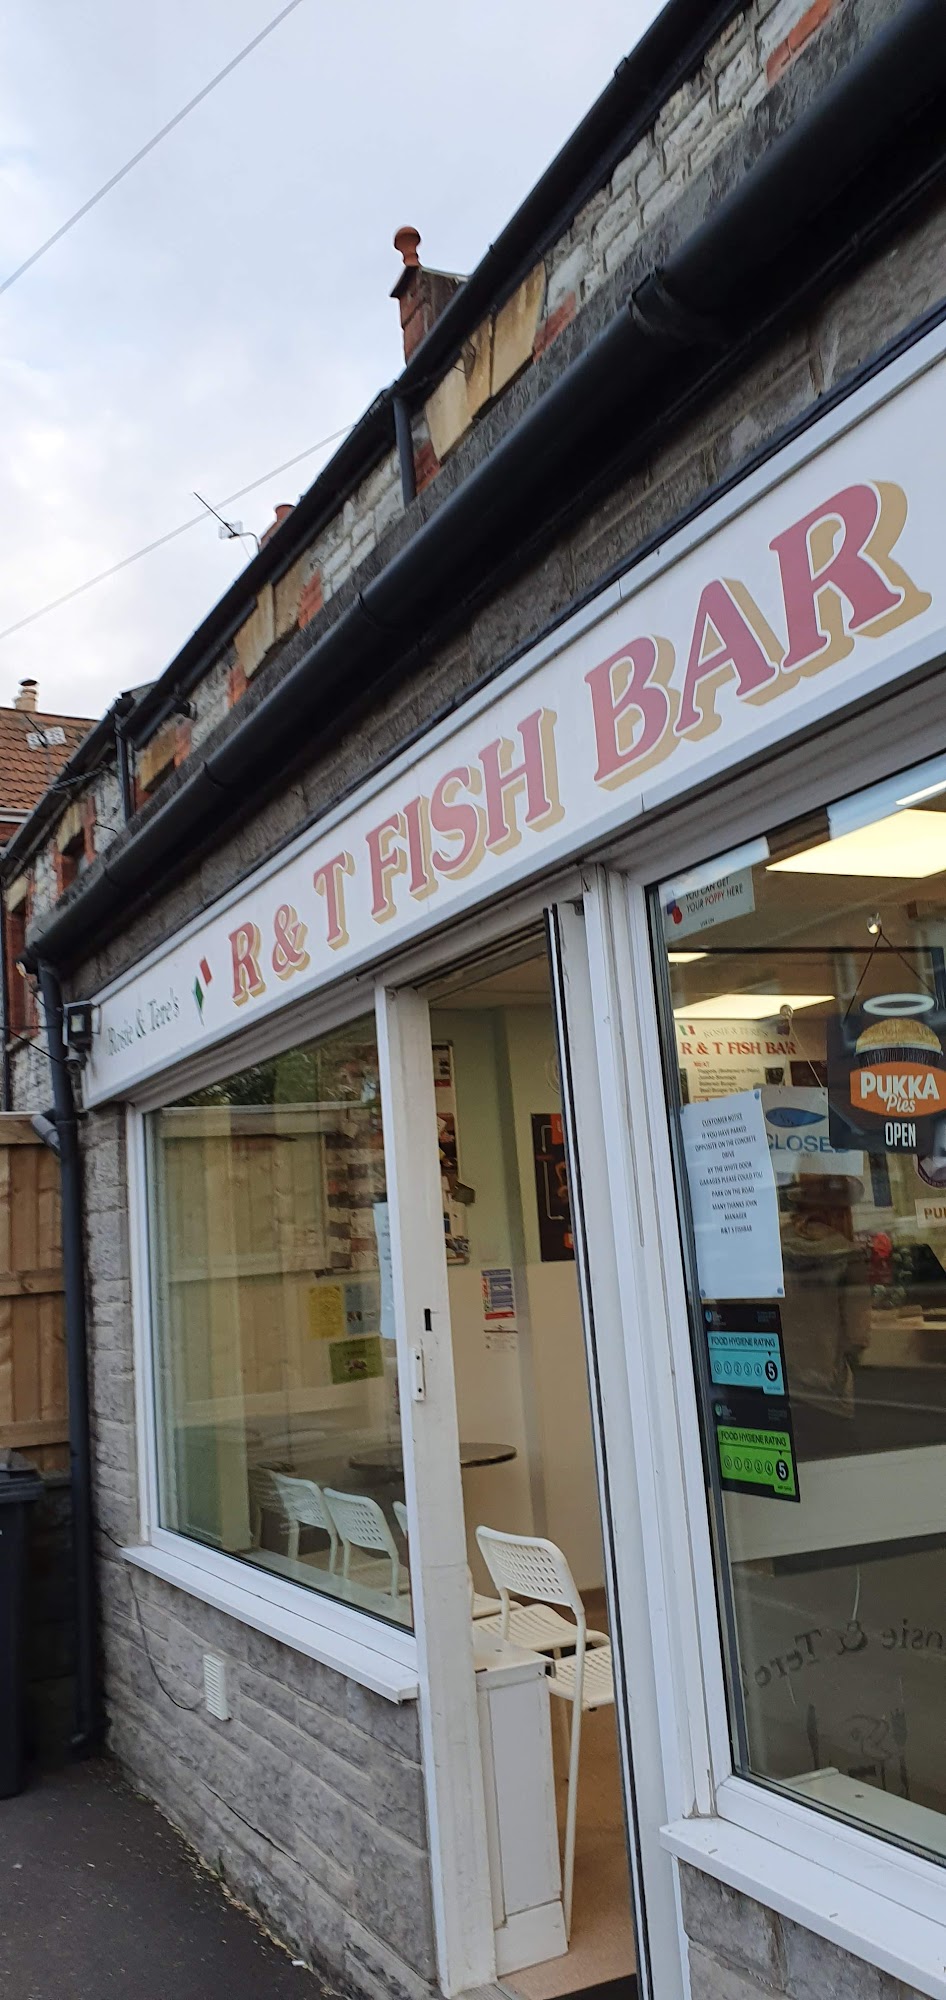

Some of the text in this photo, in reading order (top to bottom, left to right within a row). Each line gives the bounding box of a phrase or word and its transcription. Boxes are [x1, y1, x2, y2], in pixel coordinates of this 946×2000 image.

[229, 480, 933, 1007] R & T FISH BAR
[686, 882, 744, 913] YOUR POPPY HERE
[680, 1041, 797, 1055] R & T FISH BAR
[860, 1071, 940, 1101] PUKKA
[884, 1092, 916, 1114] Pies
[702, 1112, 743, 1127] CUSTOMER NOTICE
[707, 1131, 718, 1139] YOU
[718, 1128, 730, 1137] HAVE
[730, 1126, 747, 1135] PARKED
[885, 1122, 916, 1148] OPEN
[695, 1142, 717, 1152] OPPOSITE
[734, 1135, 756, 1146] CONCRETE
[767, 1134, 848, 1153] LOSE
[722, 1151, 735, 1159] DRIVE
[714, 1165, 723, 1173] THE
[723, 1163, 738, 1172] WHITE
[738, 1161, 752, 1169] DOOR
[699, 1177, 721, 1186] GARAGES
[721, 1174, 737, 1184] PLEASE
[737, 1173, 752, 1182] COULD
[741, 1186, 755, 1194] ROAD
[712, 1203, 727, 1211] MANY
[727, 1201, 745, 1209] THANKS
[924, 1207, 946, 1219] PU
[724, 1212, 747, 1221] MANAGER
[711, 1336, 775, 1347] FOOD HYGIENE RATING
[767, 1362, 776, 1380] 5
[721, 1431, 786, 1446] FOOD HYGIENE RATING
[778, 1461, 787, 1479] 5
